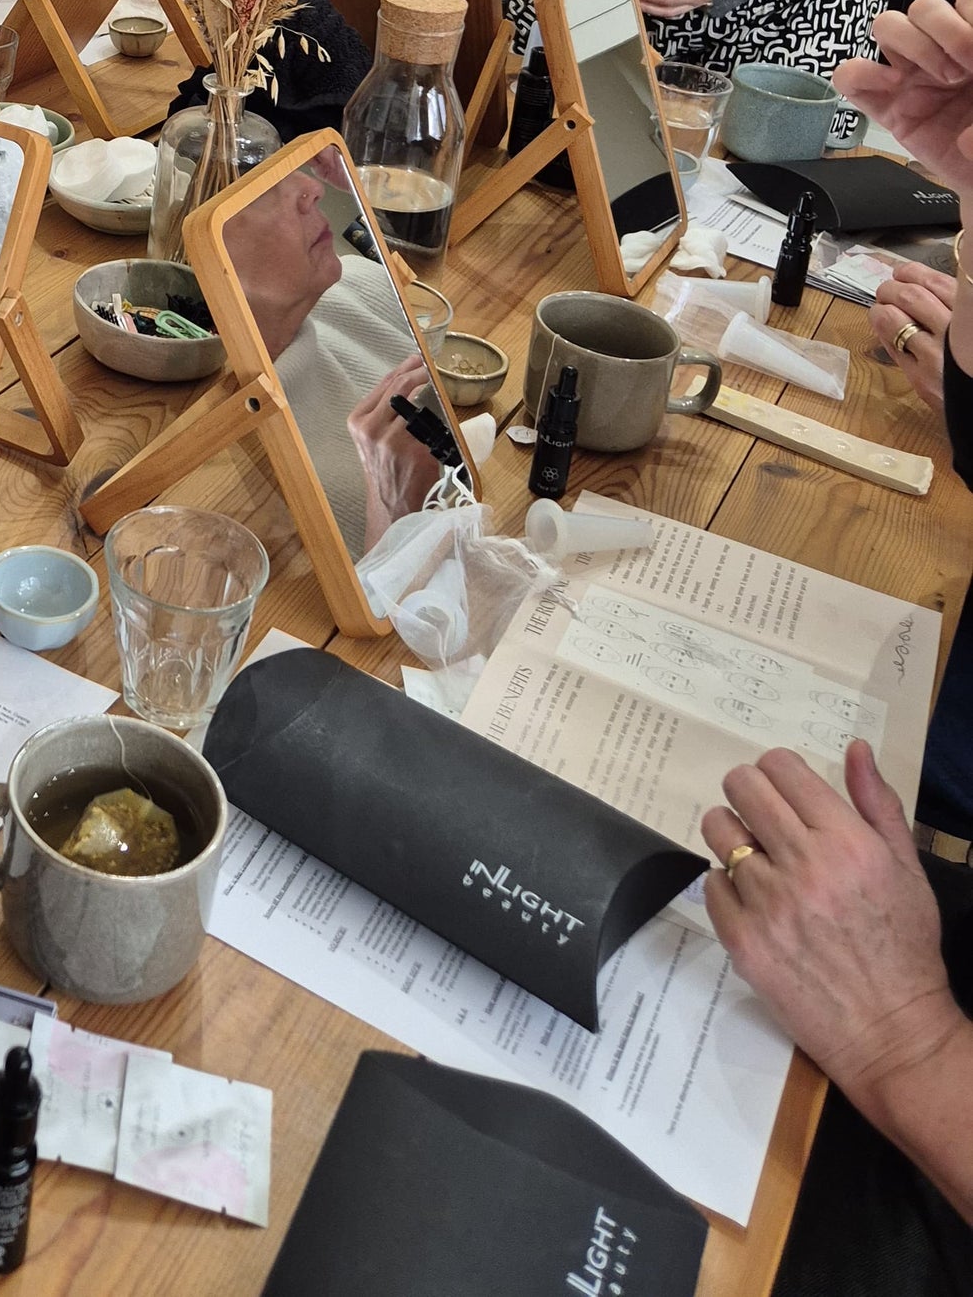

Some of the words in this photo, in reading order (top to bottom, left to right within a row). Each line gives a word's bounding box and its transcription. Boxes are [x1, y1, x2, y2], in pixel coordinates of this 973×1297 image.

[525, 612, 547, 636] THE
[486, 719, 506, 741] HE
[500, 664, 533, 720] BENEFITS
[462, 873, 569, 946] beauty
[469, 858, 585, 932] INLIGHT
[567, 1205, 618, 1297] LIGHT
[608, 1226, 639, 1296] auty
